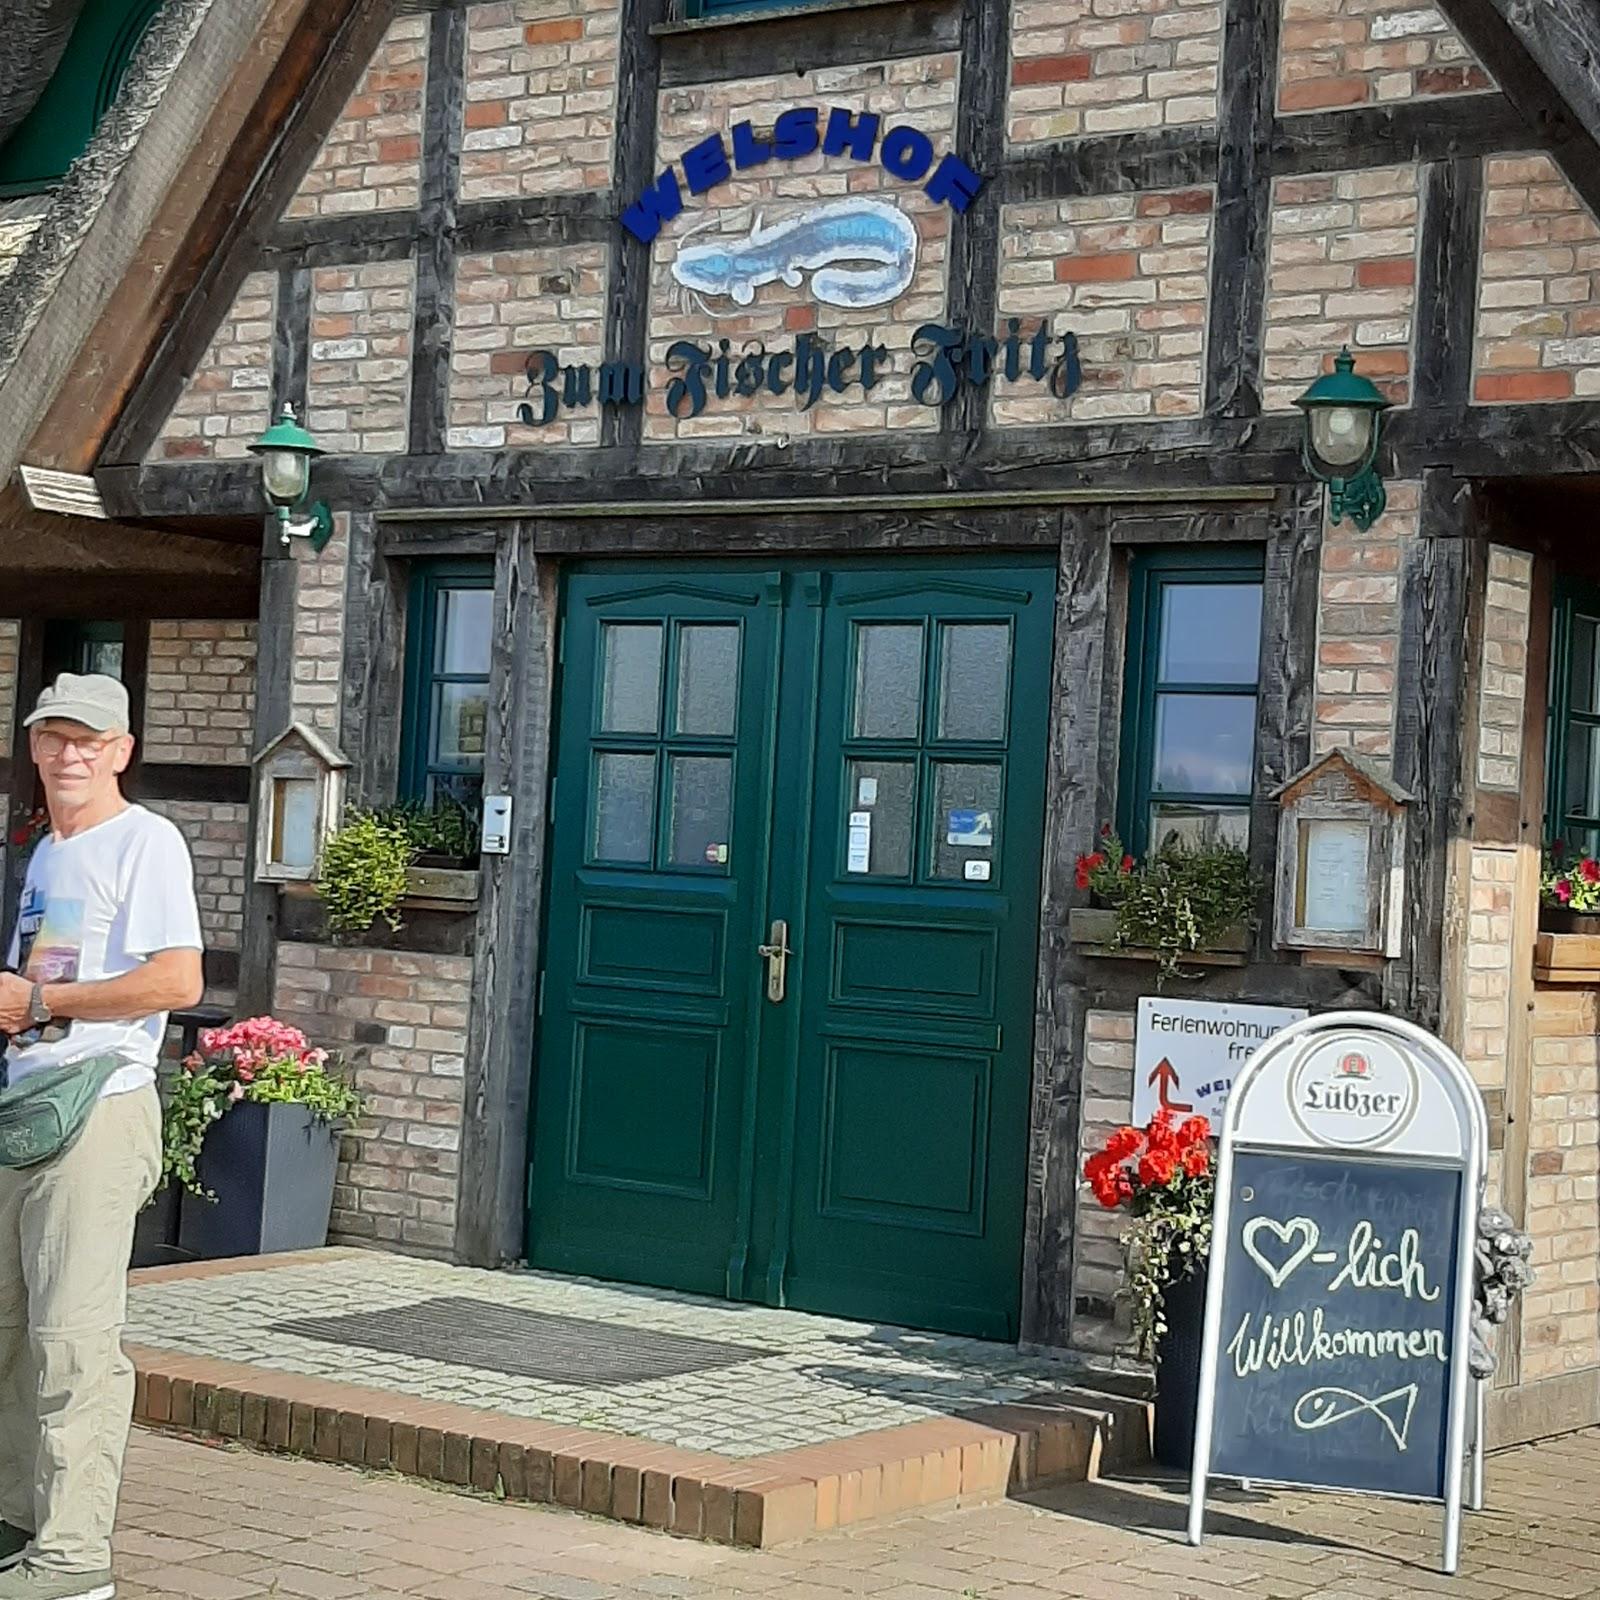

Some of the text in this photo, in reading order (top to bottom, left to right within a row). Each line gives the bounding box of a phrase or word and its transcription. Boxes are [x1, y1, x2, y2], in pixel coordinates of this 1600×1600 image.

[619, 106, 982, 244] WELSHOF
[516, 317, 1082, 427] Zum Fischer Fritz
[1303, 1081, 1401, 1117] Lübzer
[1226, 1306, 1449, 1378] Willkommen
